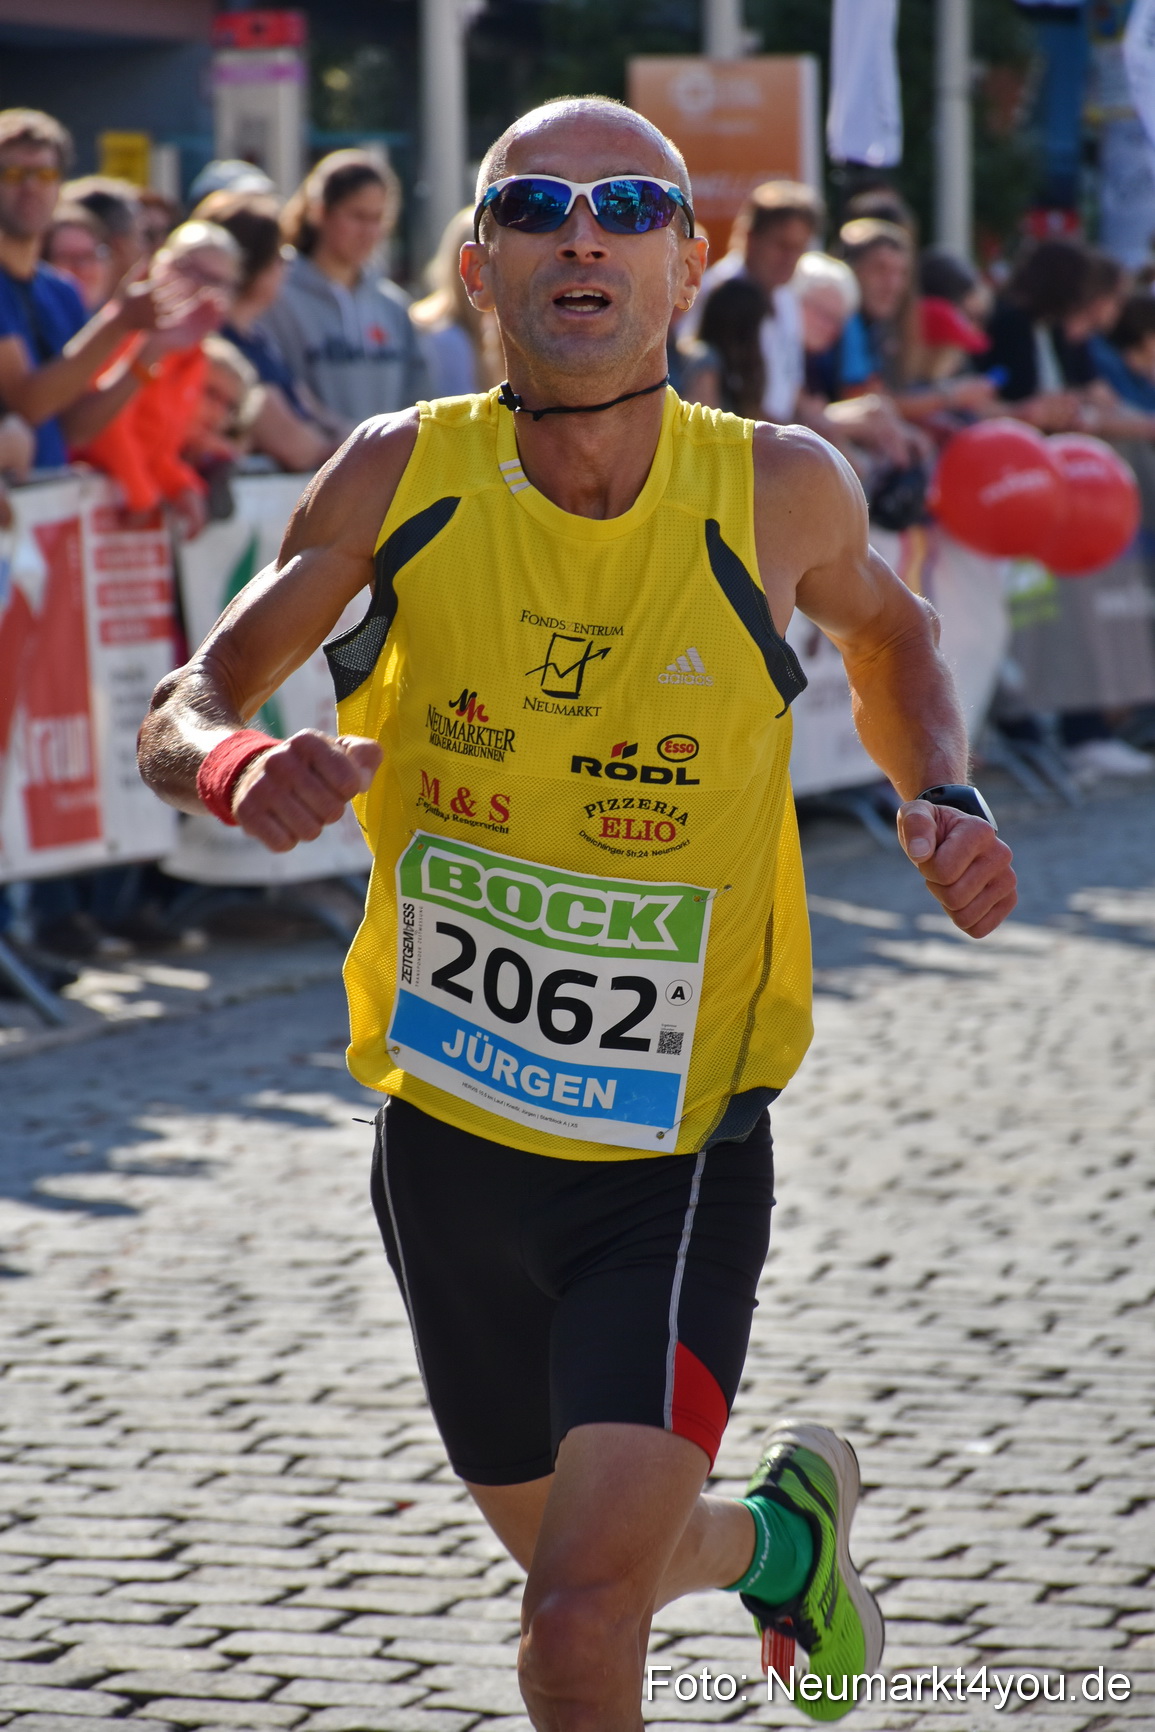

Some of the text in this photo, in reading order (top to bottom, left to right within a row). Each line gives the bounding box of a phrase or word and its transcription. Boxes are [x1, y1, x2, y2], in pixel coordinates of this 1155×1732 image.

[522, 696, 602, 717] NEUMARKT
[426, 704, 516, 752] NEUMARKTER
[429, 732, 505, 762] MINERALBRUNNEN
[419, 768, 511, 823] M & S
[584, 798, 689, 826] PIZZERIA
[599, 817, 676, 842] ELIO
[652, 840, 690, 856] Neumarkt
[424, 849, 682, 950] BOCK
[432, 922, 657, 1052] 2062
[671, 986, 686, 1000] A
[442, 1028, 617, 1110] JÜRGEN
